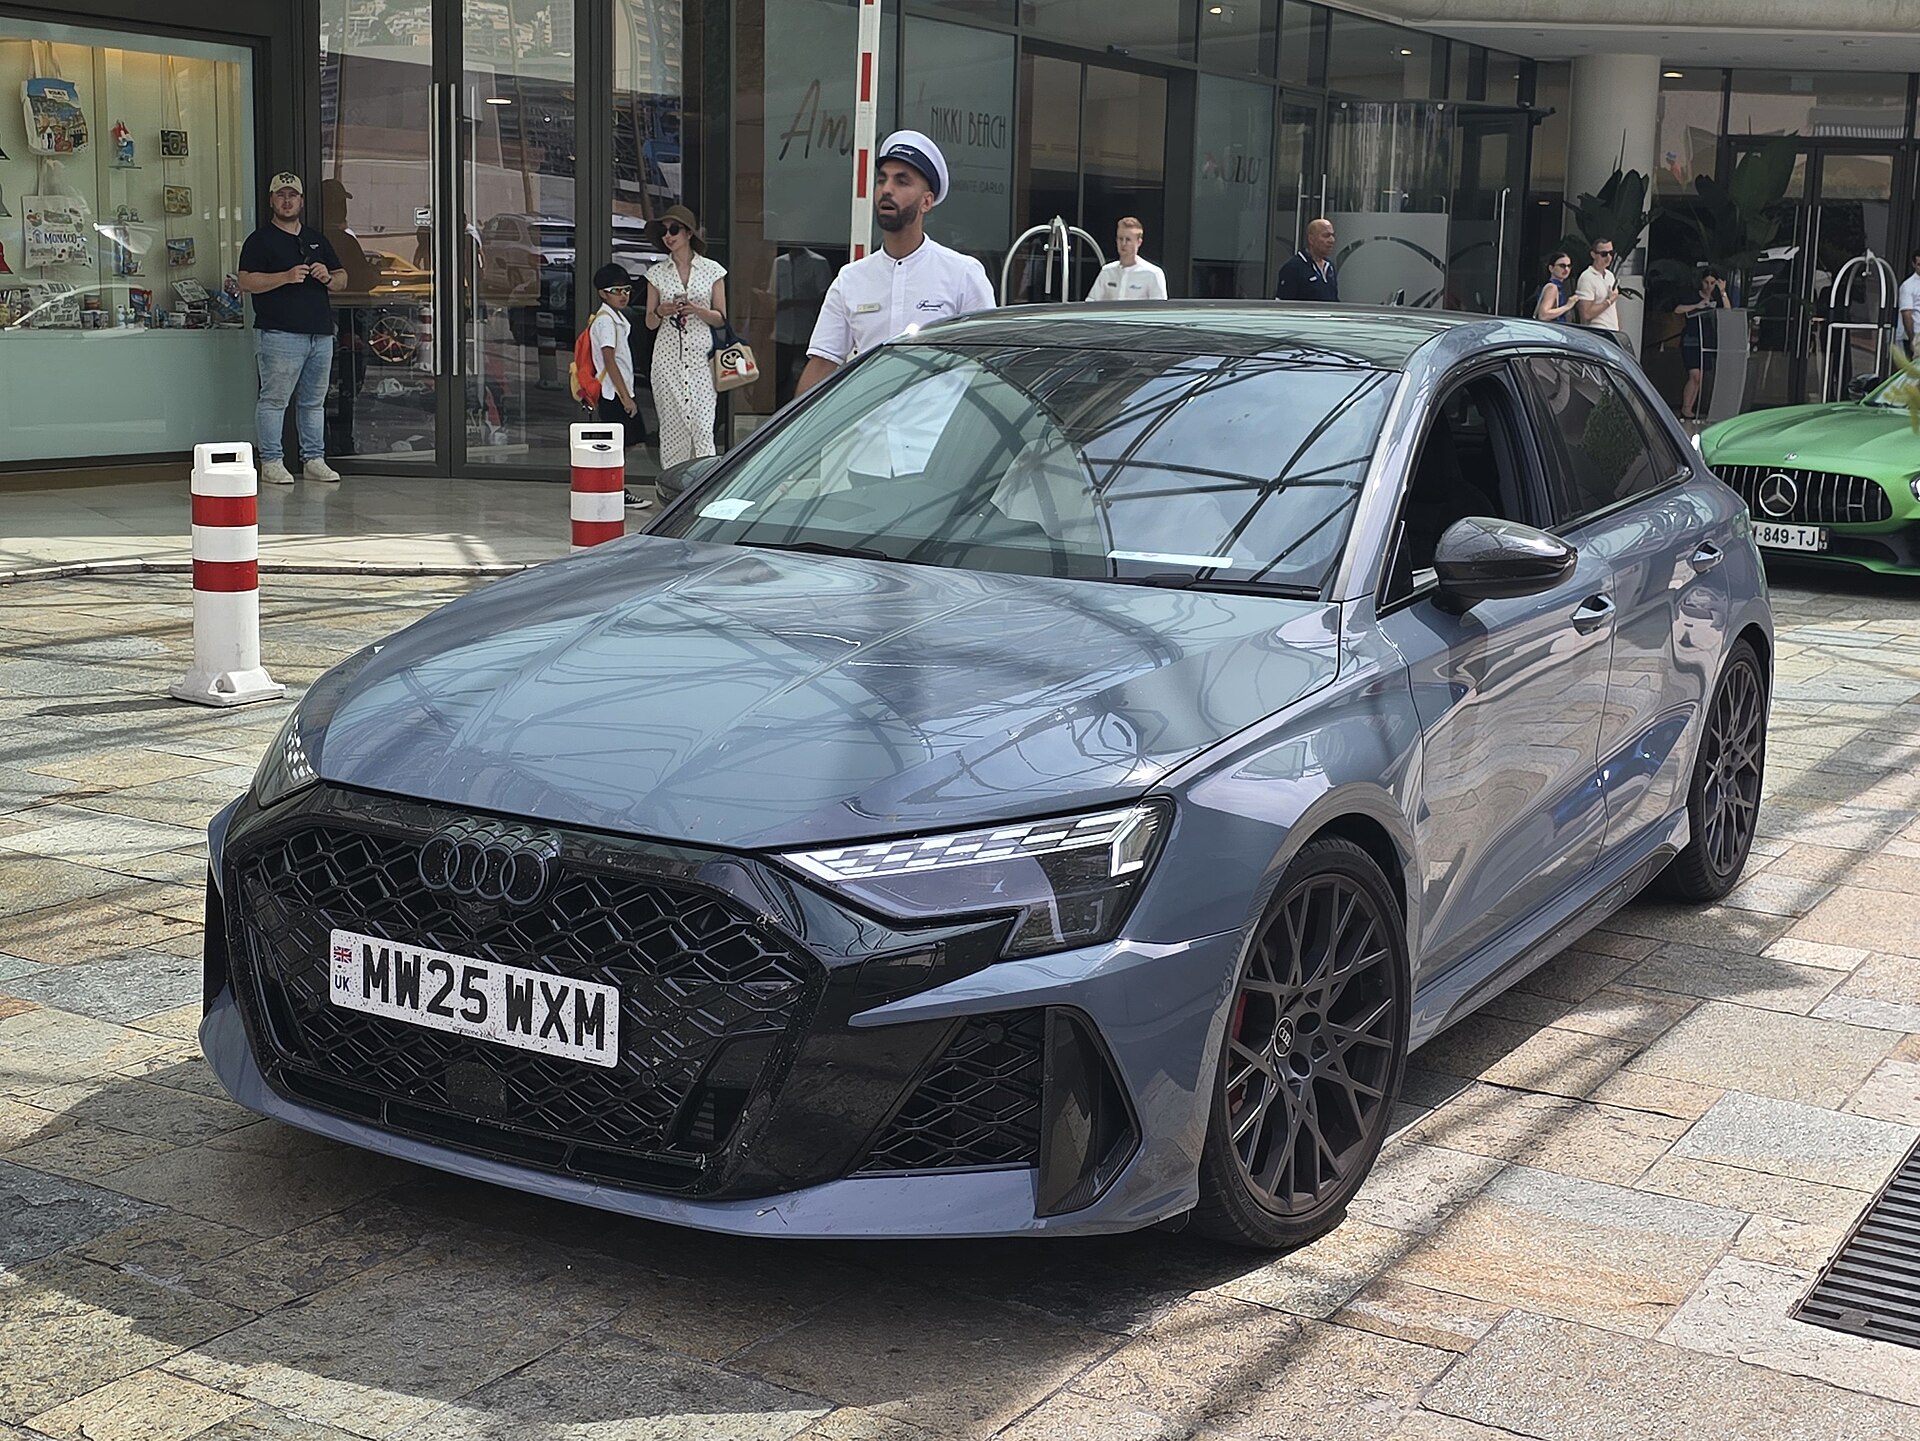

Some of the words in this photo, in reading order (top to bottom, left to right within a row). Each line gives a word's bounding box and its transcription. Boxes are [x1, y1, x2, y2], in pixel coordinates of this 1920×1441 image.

[930, 106, 962, 144] NIKKI
[968, 112, 1006, 149] BEACH
[334, 974, 350, 992] UK
[362, 943, 488, 1024] MW25
[505, 974, 605, 1051] WXM
